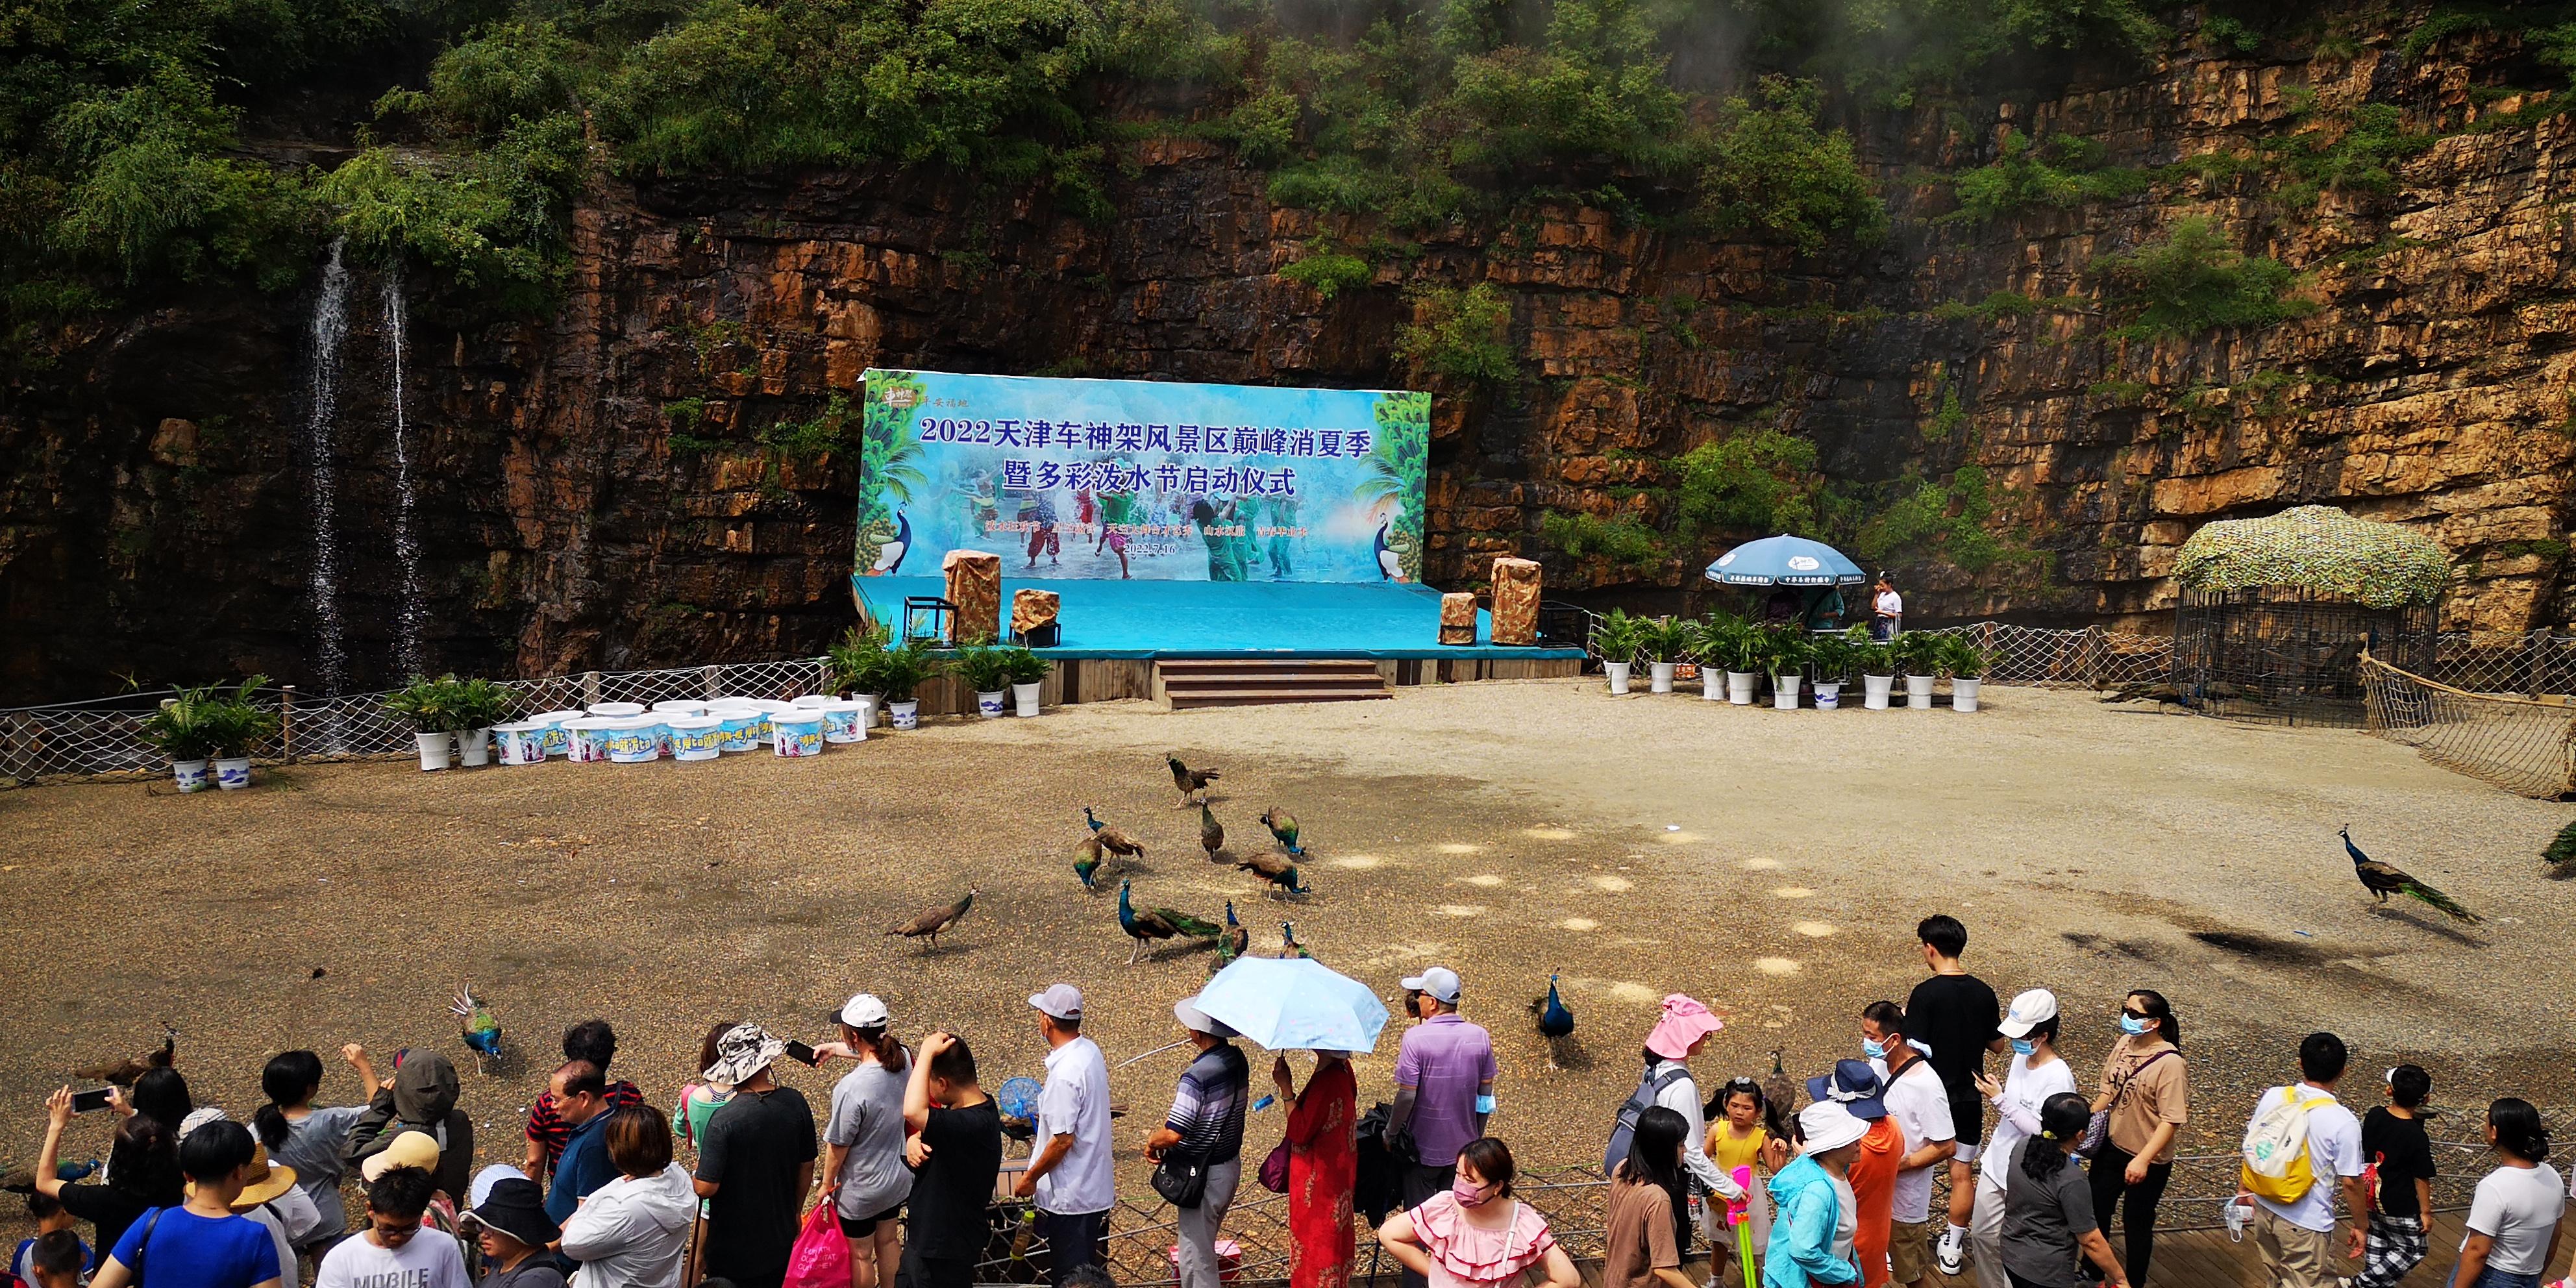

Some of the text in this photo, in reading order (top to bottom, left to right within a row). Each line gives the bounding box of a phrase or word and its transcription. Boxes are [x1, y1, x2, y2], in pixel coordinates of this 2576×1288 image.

[922, 395, 970, 408] 平安福地
[920, 417, 1372, 458] 2022天津车神架风景区巅峰消夏季
[1003, 459, 1295, 495] 暨多彩泼水节启动仪式
[1204, 525, 1246, 538] 山水汉服
[1124, 543, 1176, 555] 2022.7.16
[353, 1268, 429, 1288] MOBILE
